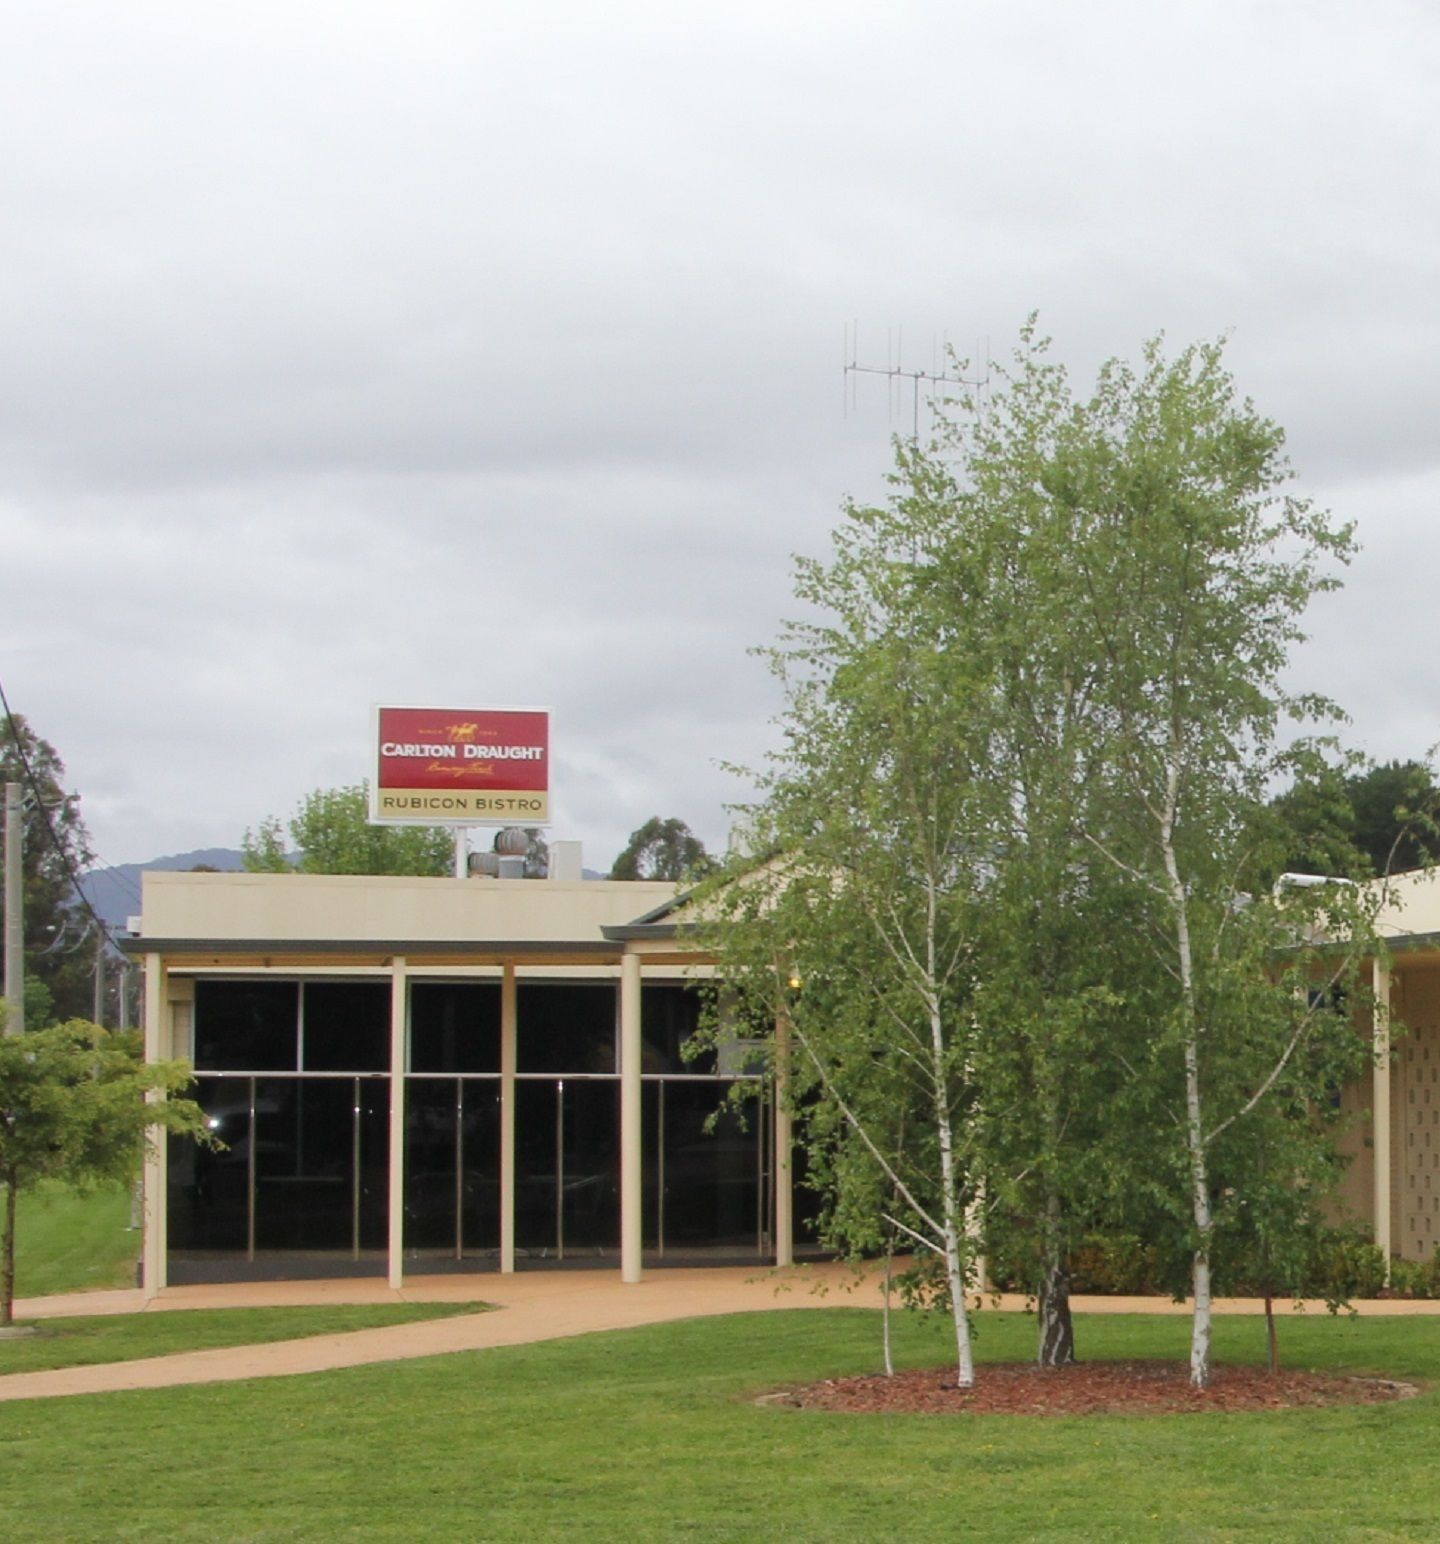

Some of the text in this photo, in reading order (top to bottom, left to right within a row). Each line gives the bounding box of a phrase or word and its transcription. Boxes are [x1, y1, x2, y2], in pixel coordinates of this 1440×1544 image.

[382, 743, 544, 760] CARLTON DRAUGHT
[383, 797, 542, 810] RUBICON BISTRO
